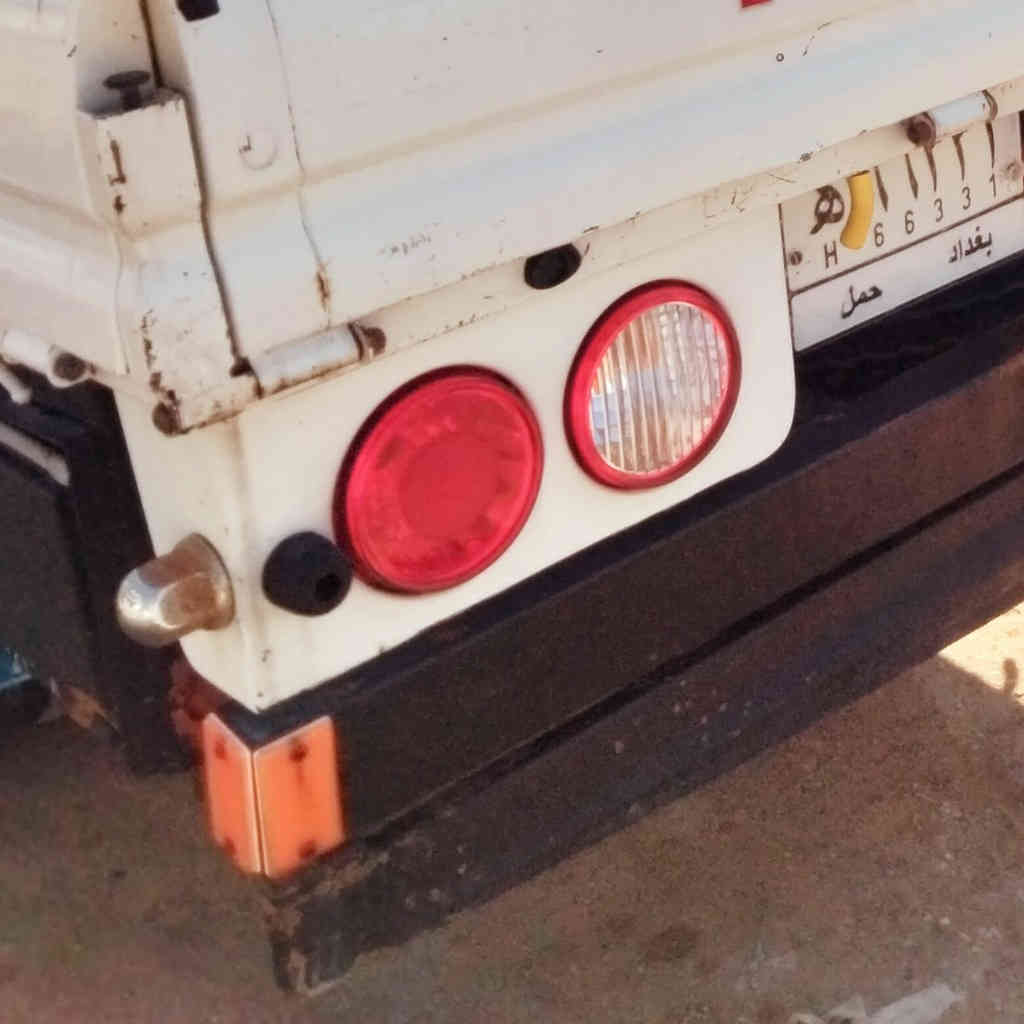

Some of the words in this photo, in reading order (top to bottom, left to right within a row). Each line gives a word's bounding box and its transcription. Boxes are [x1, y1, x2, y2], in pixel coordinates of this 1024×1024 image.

[823, 240, 838, 268] H
[873, 173, 997, 247] 66331
[948, 225, 993, 264] بغداد
[840, 284, 883, 319] حمل
